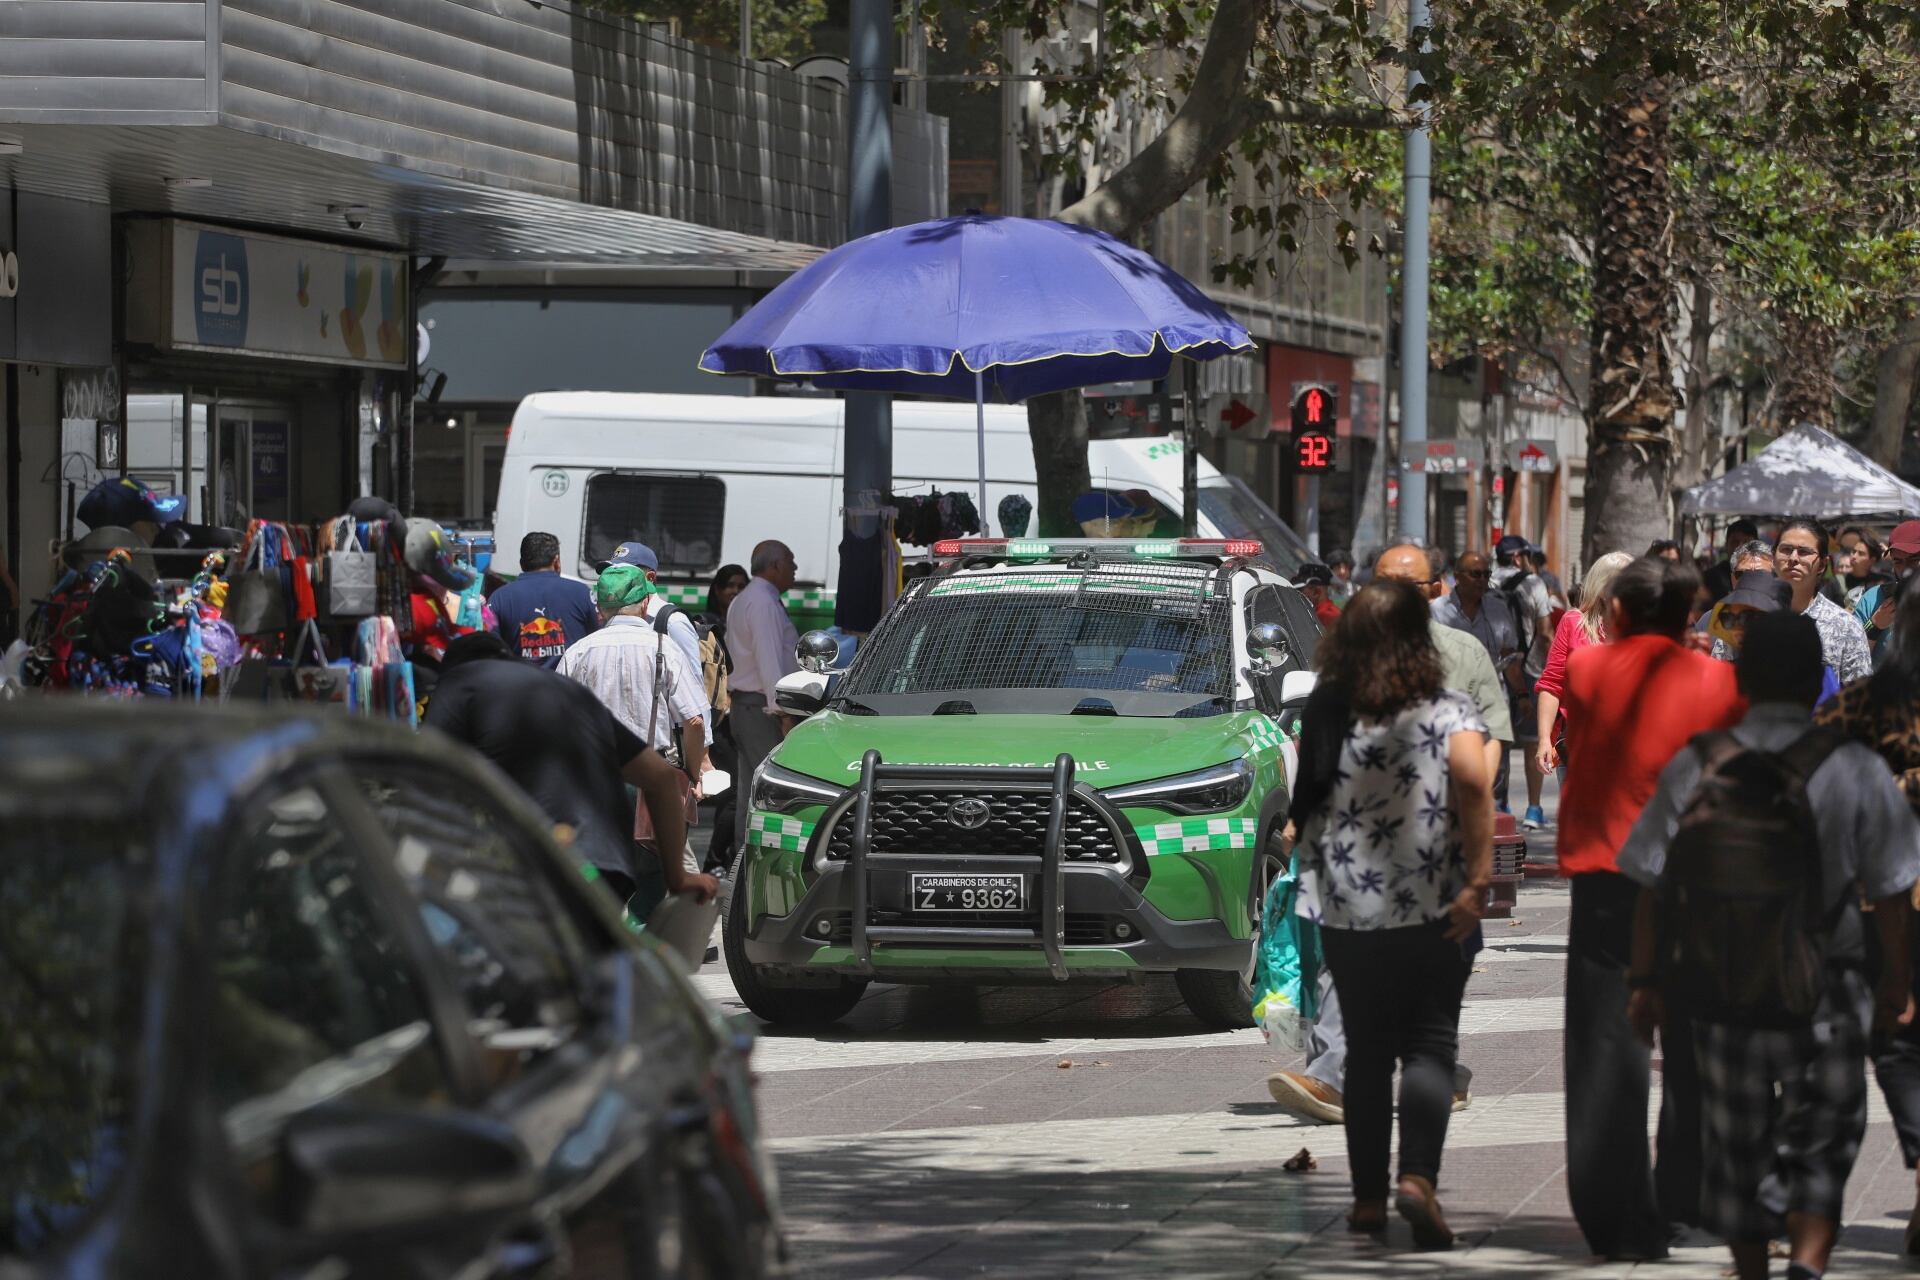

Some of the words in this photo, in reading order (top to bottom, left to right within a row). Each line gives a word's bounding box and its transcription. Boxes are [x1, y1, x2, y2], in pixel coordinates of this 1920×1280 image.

[1300, 436, 1328, 467] 32
[522, 647, 553, 658] Mobil
[922, 878, 977, 887] CARABINEROS
[977, 878, 989, 887] DE
[989, 878, 1012, 887] CHILE
[921, 888, 936, 908] Z
[961, 888, 1017, 909] 9362
